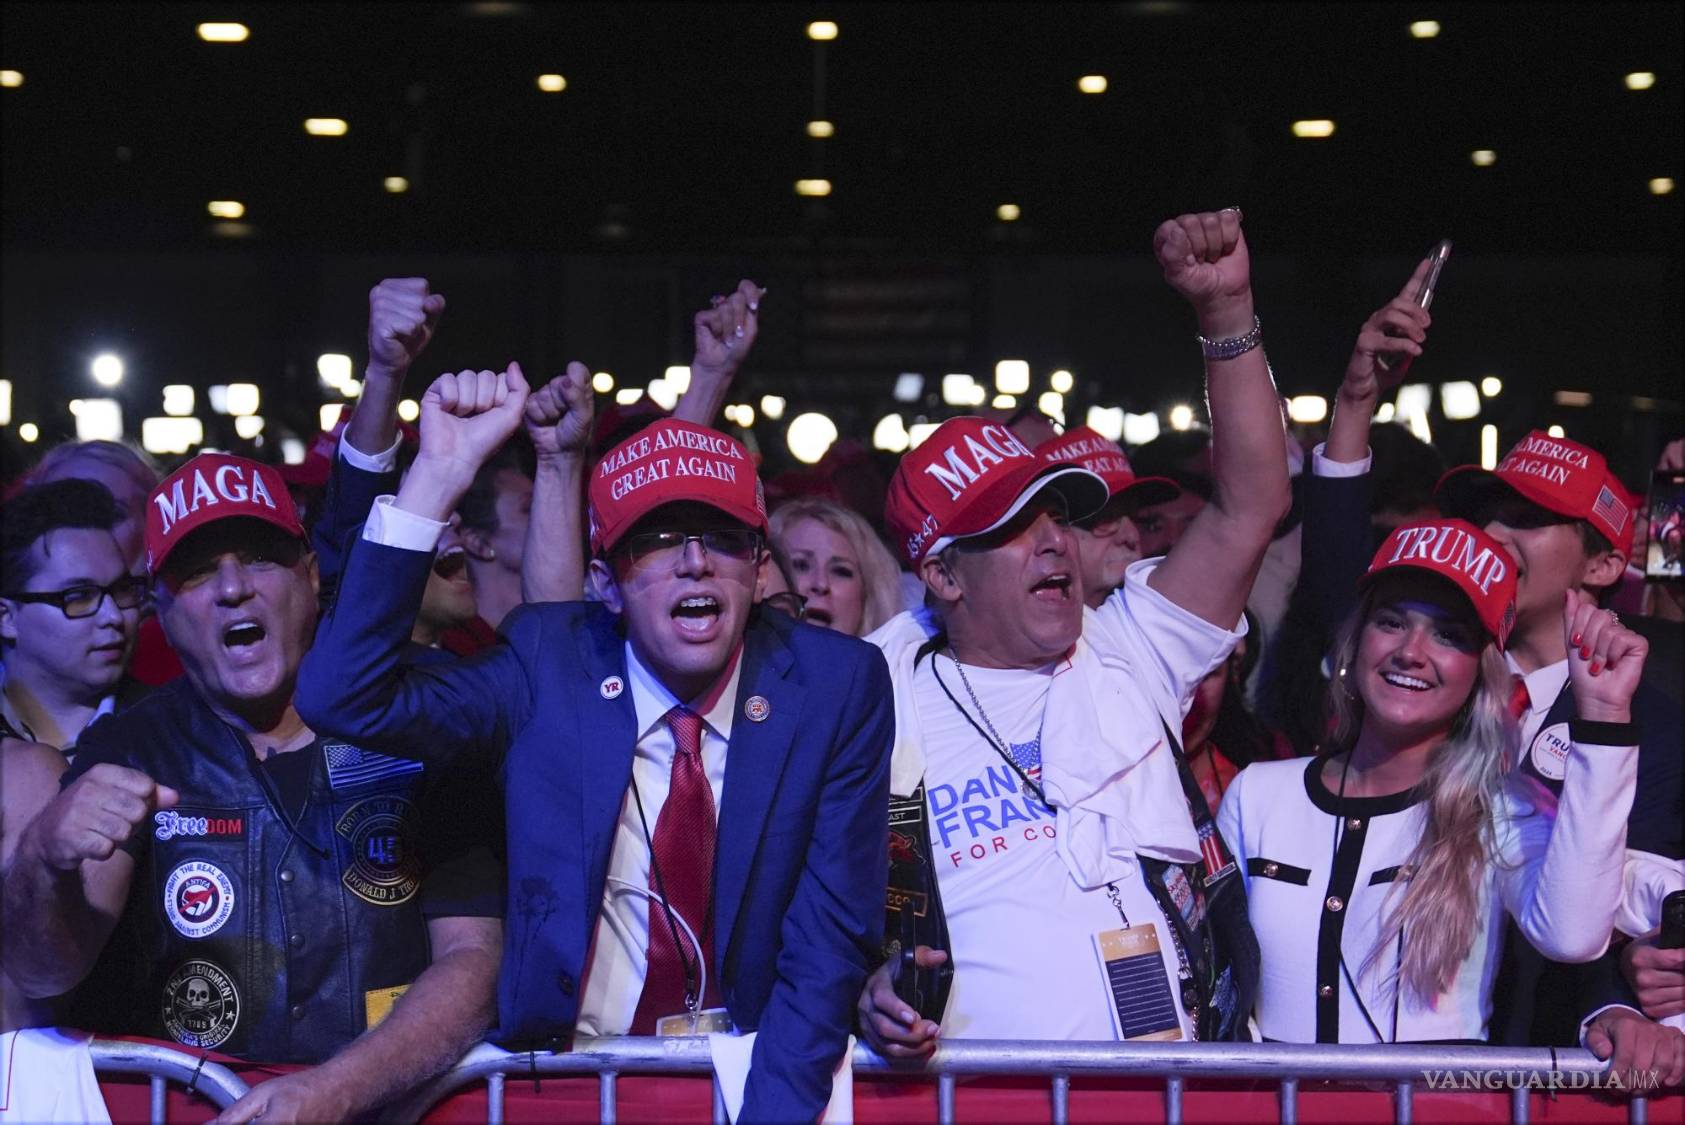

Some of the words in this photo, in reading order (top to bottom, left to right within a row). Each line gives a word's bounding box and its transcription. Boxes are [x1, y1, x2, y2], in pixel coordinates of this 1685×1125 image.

[600, 436, 650, 479] MAKE
[653, 428, 744, 460] AMERICA
[1045, 440, 1093, 462] MAKE
[611, 458, 670, 500] GREAT
[675, 456, 736, 484] AGAIN
[1513, 459, 1571, 486] AGAIN
[154, 464, 276, 535] MAGA
[1388, 526, 1507, 595] TRUMP
[604, 681, 619, 693] YR
[1546, 733, 1569, 751] TRU
[1550, 746, 1567, 759] VAN
[889, 812, 906, 821] AST
[936, 796, 1057, 849] FRAN
[950, 836, 1008, 868] FOR
[1024, 825, 1057, 841] CO
[180, 863, 194, 875] THE
[196, 863, 215, 876] REAL
[347, 871, 387, 899] DONALD
[389, 887, 396, 900] J
[200, 1024, 231, 1047] SECURITY
